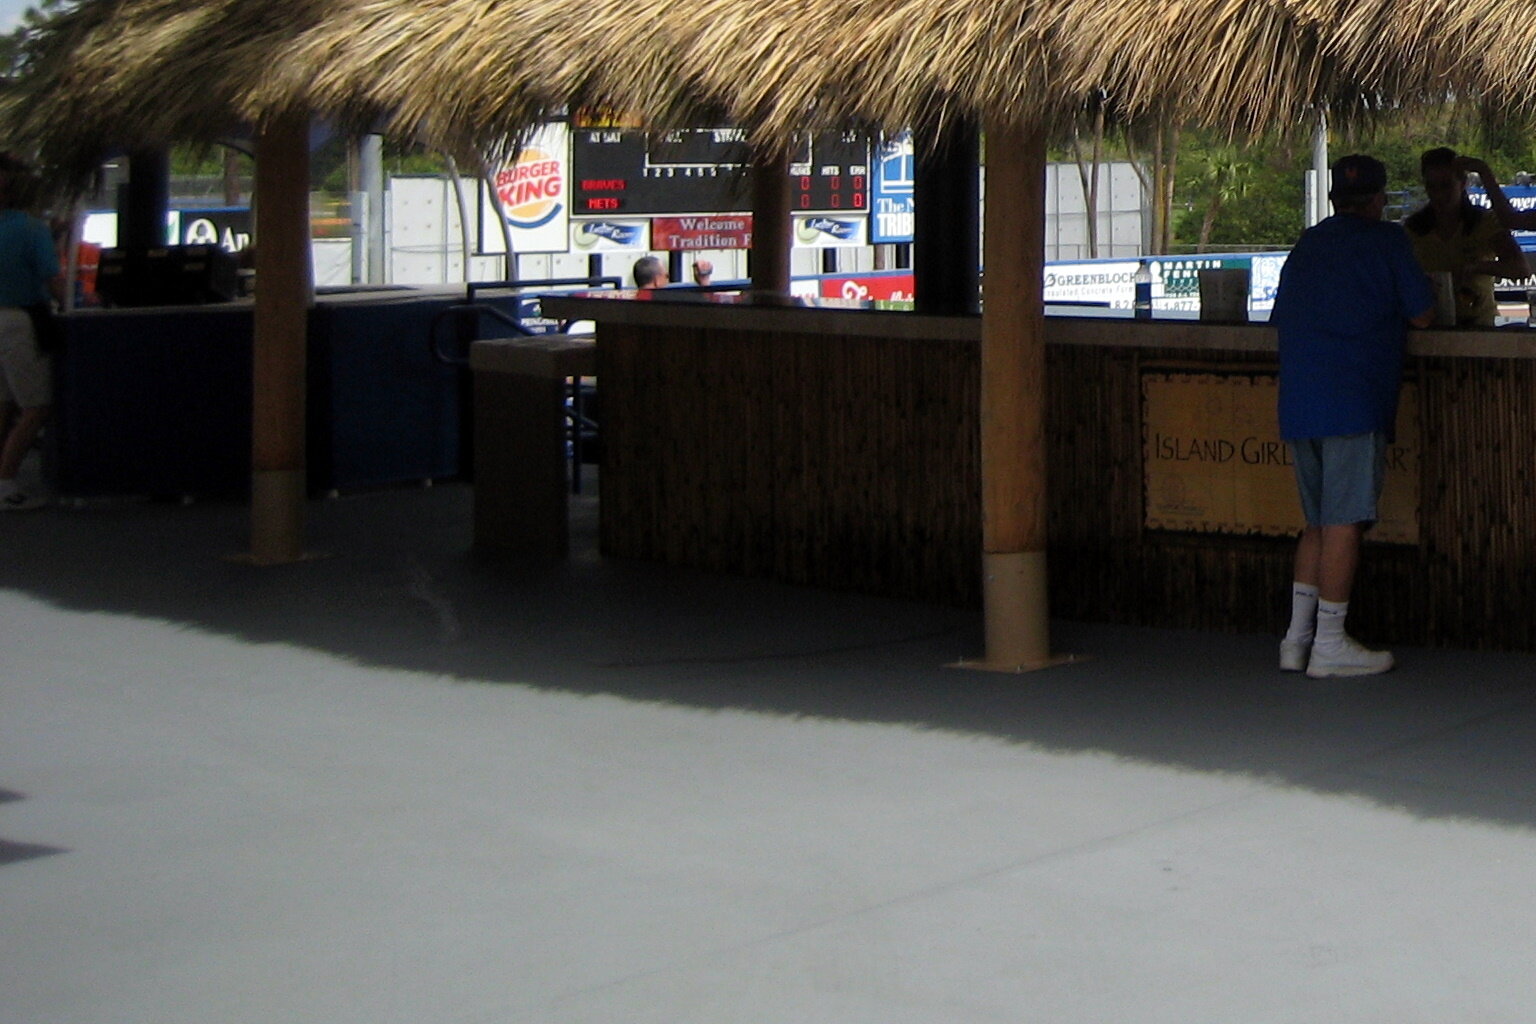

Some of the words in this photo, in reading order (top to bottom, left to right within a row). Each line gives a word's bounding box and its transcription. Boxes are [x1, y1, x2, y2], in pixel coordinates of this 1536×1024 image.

[496, 160, 560, 188] BURGER
[499, 177, 562, 207] KING
[587, 198, 619, 210] METS
[878, 198, 904, 213] The
[680, 218, 745, 231] Welcome
[669, 234, 737, 248] Tradition
[1163, 260, 1222, 270] MARTIN
